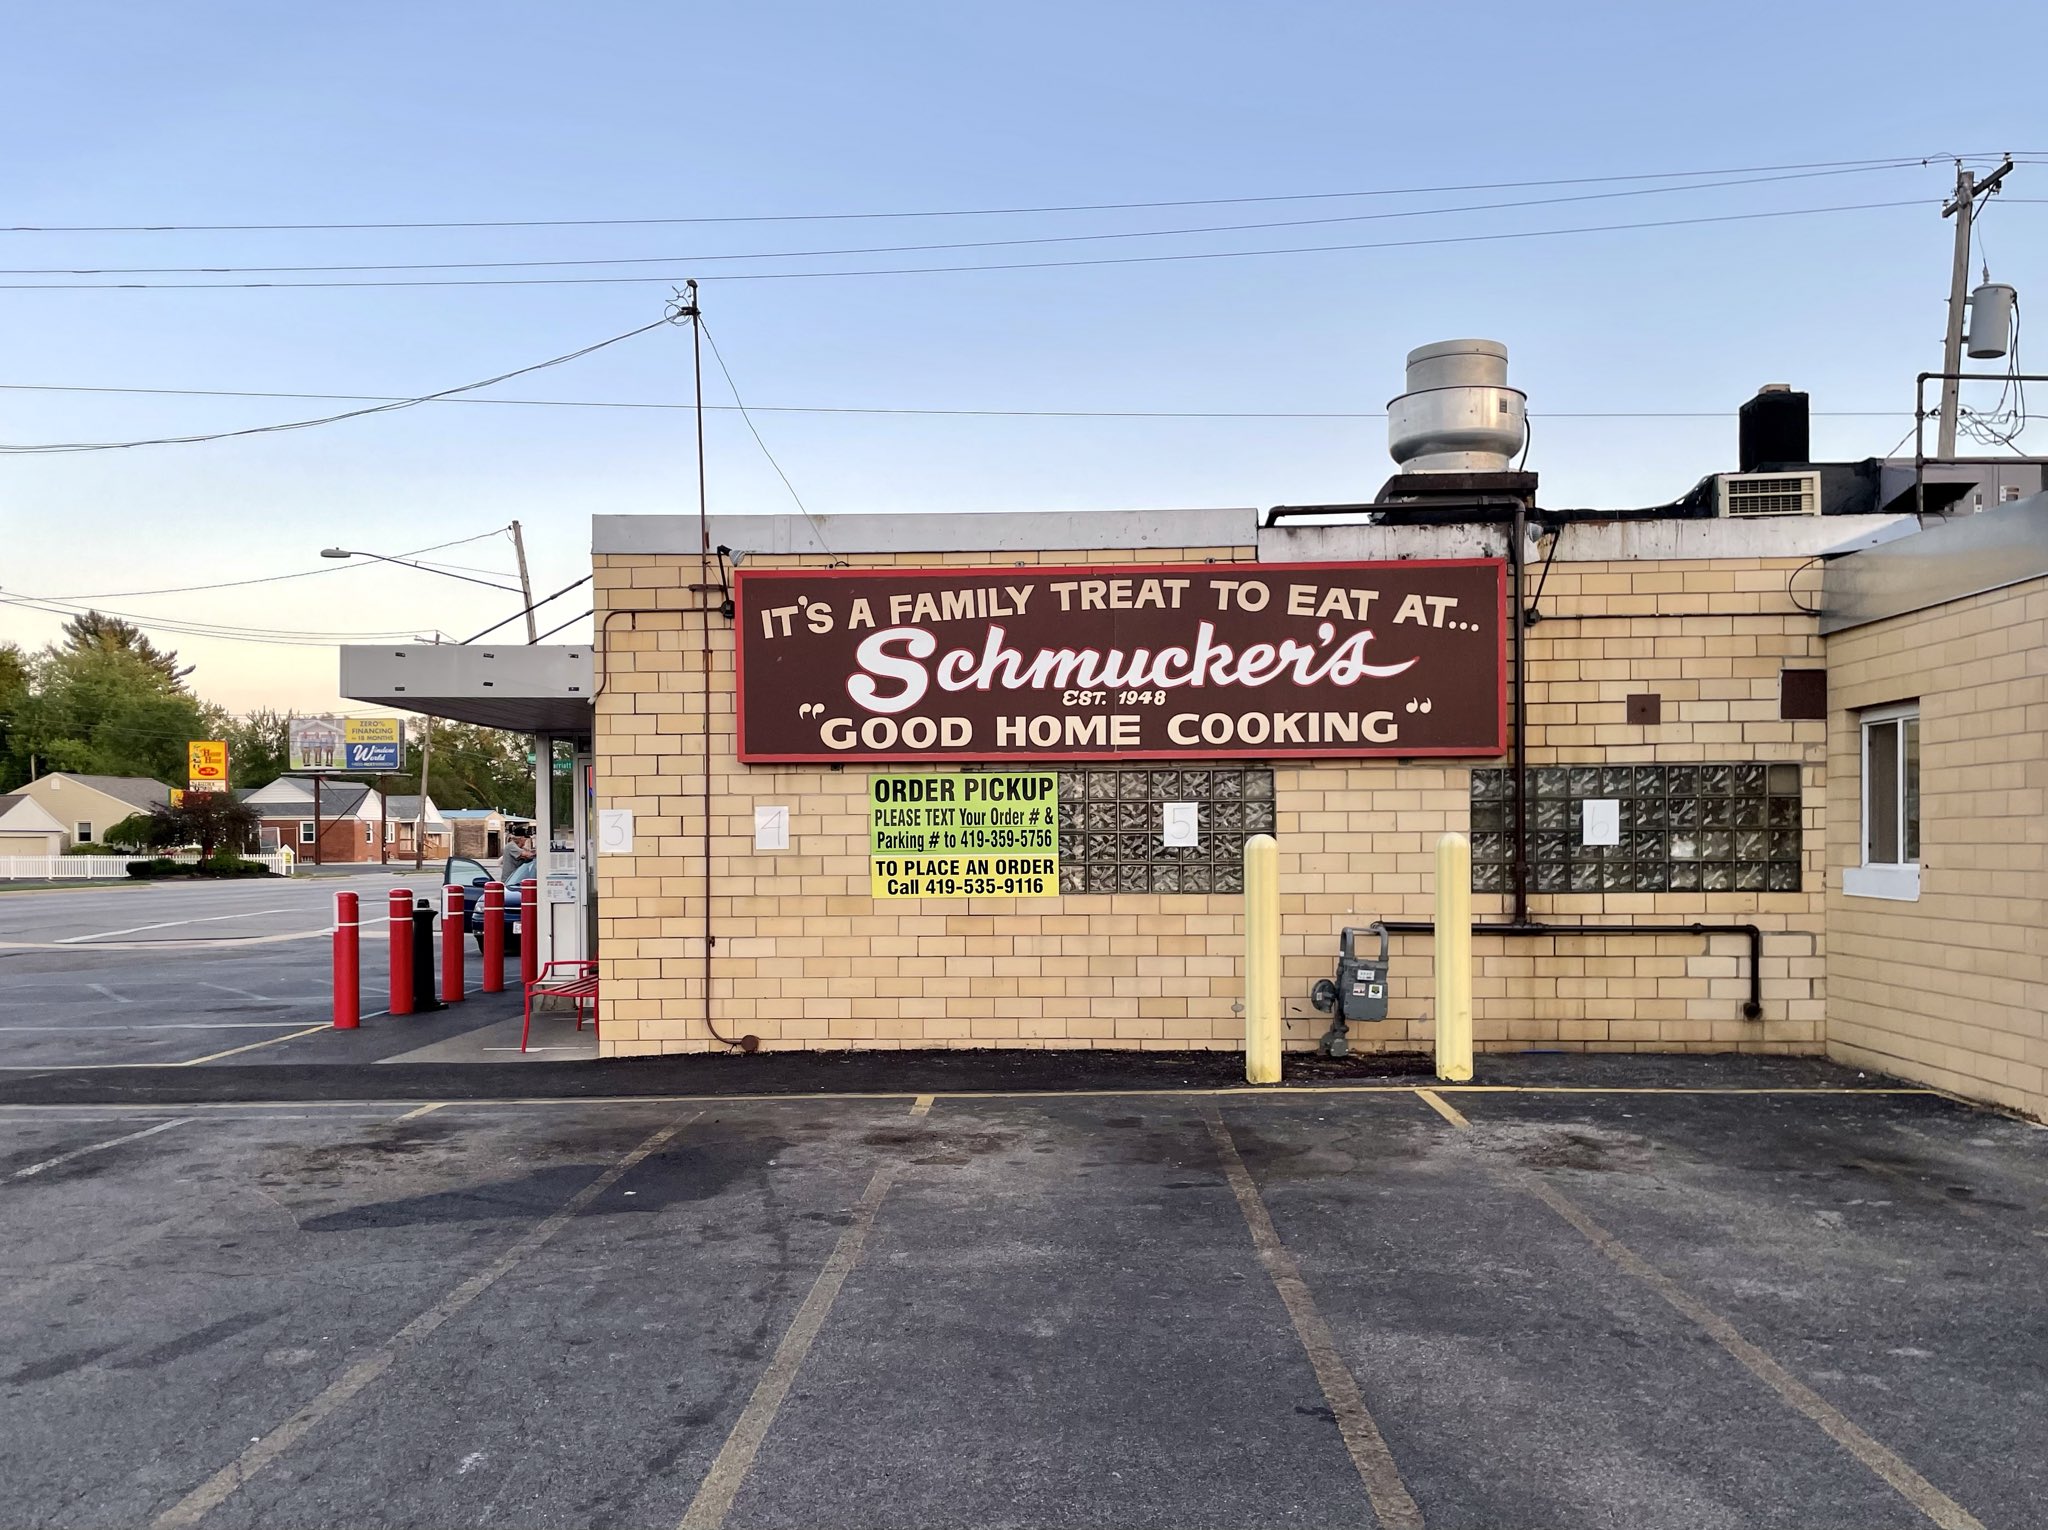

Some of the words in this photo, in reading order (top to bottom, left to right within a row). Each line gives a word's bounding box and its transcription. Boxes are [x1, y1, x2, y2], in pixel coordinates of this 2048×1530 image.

[761, 595, 834, 639] IT'S
[848, 598, 876, 630] A
[889, 584, 1035, 625] FAMILY
[1050, 578, 1191, 612] TREAT
[1209, 580, 1271, 612] TO
[1287, 583, 1379, 622] EAT
[1392, 594, 1480, 632] AT...
[845, 619, 1421, 716] Schmucker's
[1062, 689, 1107, 706] EST.
[1118, 689, 1167, 706] 1948
[995, 714, 1142, 748] HOME
[875, 779, 955, 802] ORDER
[964, 777, 1053, 801] PICKUP
[603, 813, 625, 846] 3
[761, 810, 782, 846] 4
[875, 808, 921, 827] PLEASE
[925, 808, 955, 826] TEXT
[959, 808, 986, 826] Your
[990, 807, 1024, 826] Order
[1029, 808, 1040, 825] #
[1044, 806, 1054, 825] &
[1169, 807, 1191, 840] 5
[877, 830, 924, 852] Parking
[929, 831, 940, 848] #
[944, 833, 956, 848] to
[961, 829, 1052, 848] 419-359-5756
[875, 861, 898, 877] TO
[904, 860, 960, 876] PLACE
[965, 859, 989, 875] AN
[995, 858, 1054, 875] ORDER
[887, 879, 919, 895] Call
[925, 878, 1044, 895] 419-535-9116
